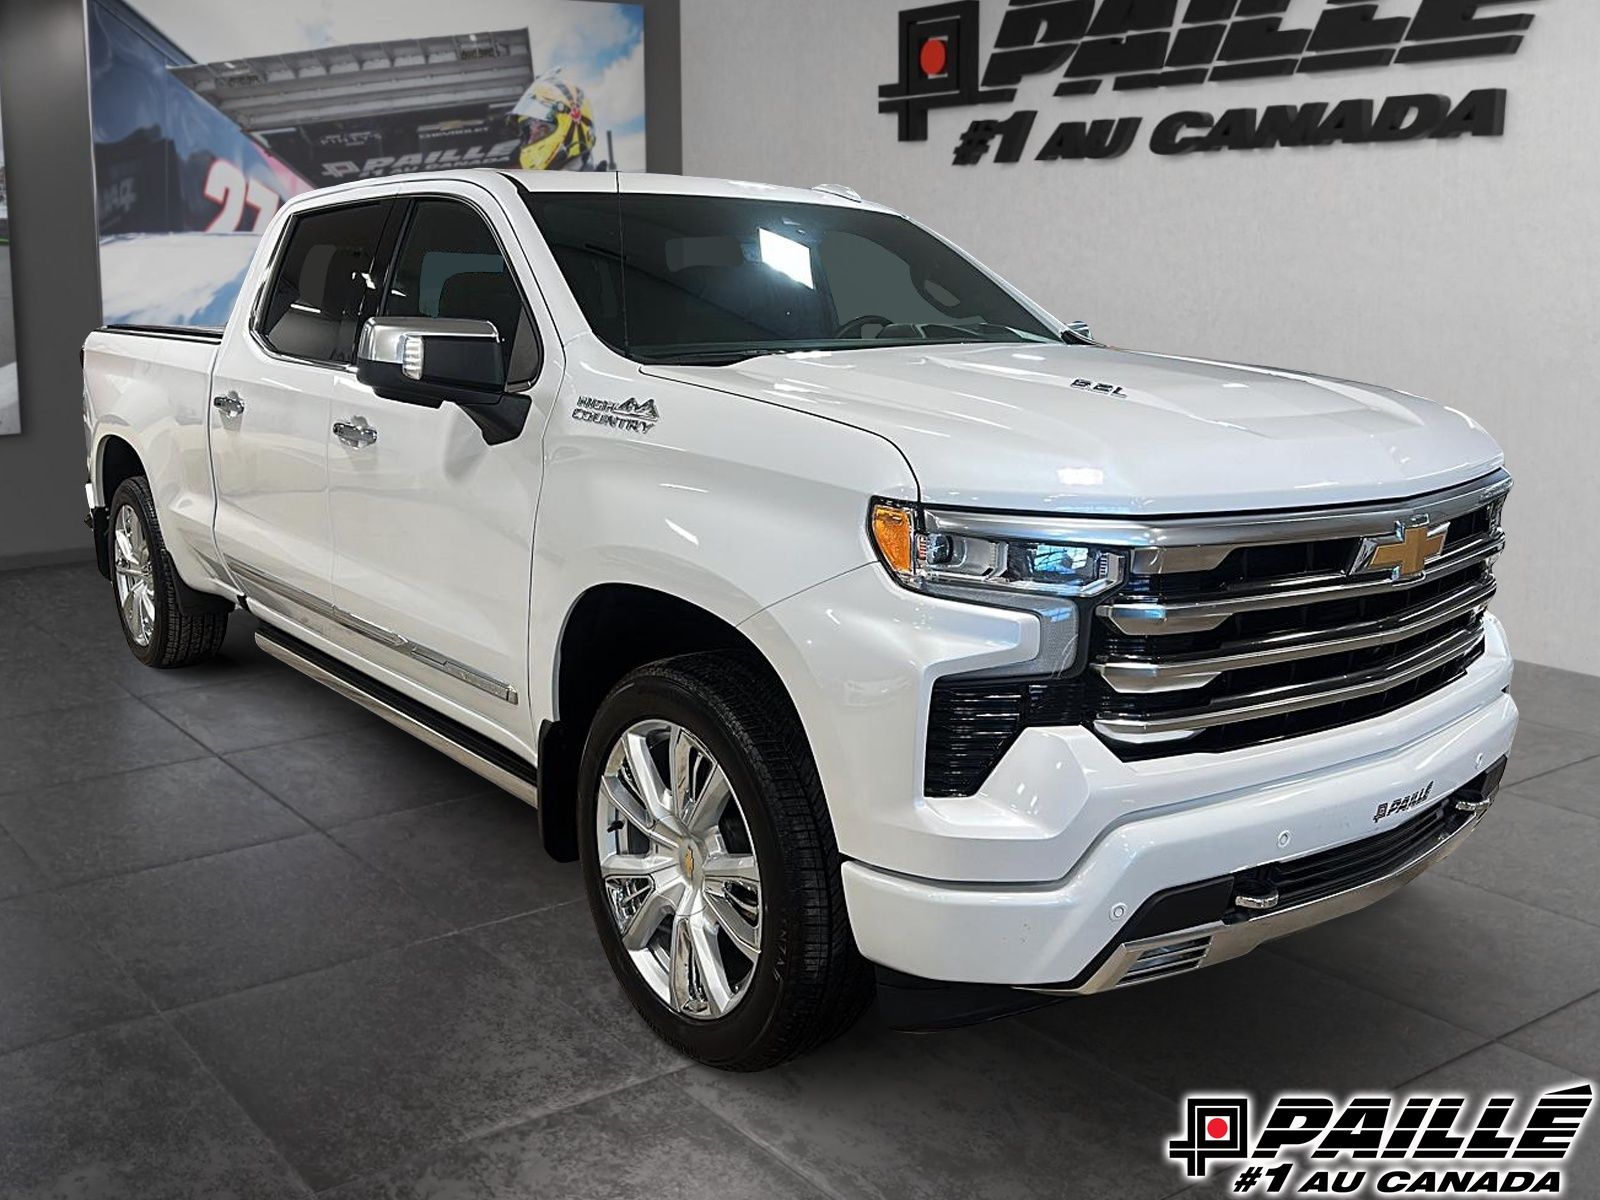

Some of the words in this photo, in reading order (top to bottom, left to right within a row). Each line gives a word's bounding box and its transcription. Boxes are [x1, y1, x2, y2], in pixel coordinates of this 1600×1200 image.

[953, 110, 1038, 166] #1
[1035, 117, 1142, 160] AU
[1149, 88, 1507, 157] CANADA
[204, 158, 279, 233] 27
[571, 408, 655, 434] COUNTRY
